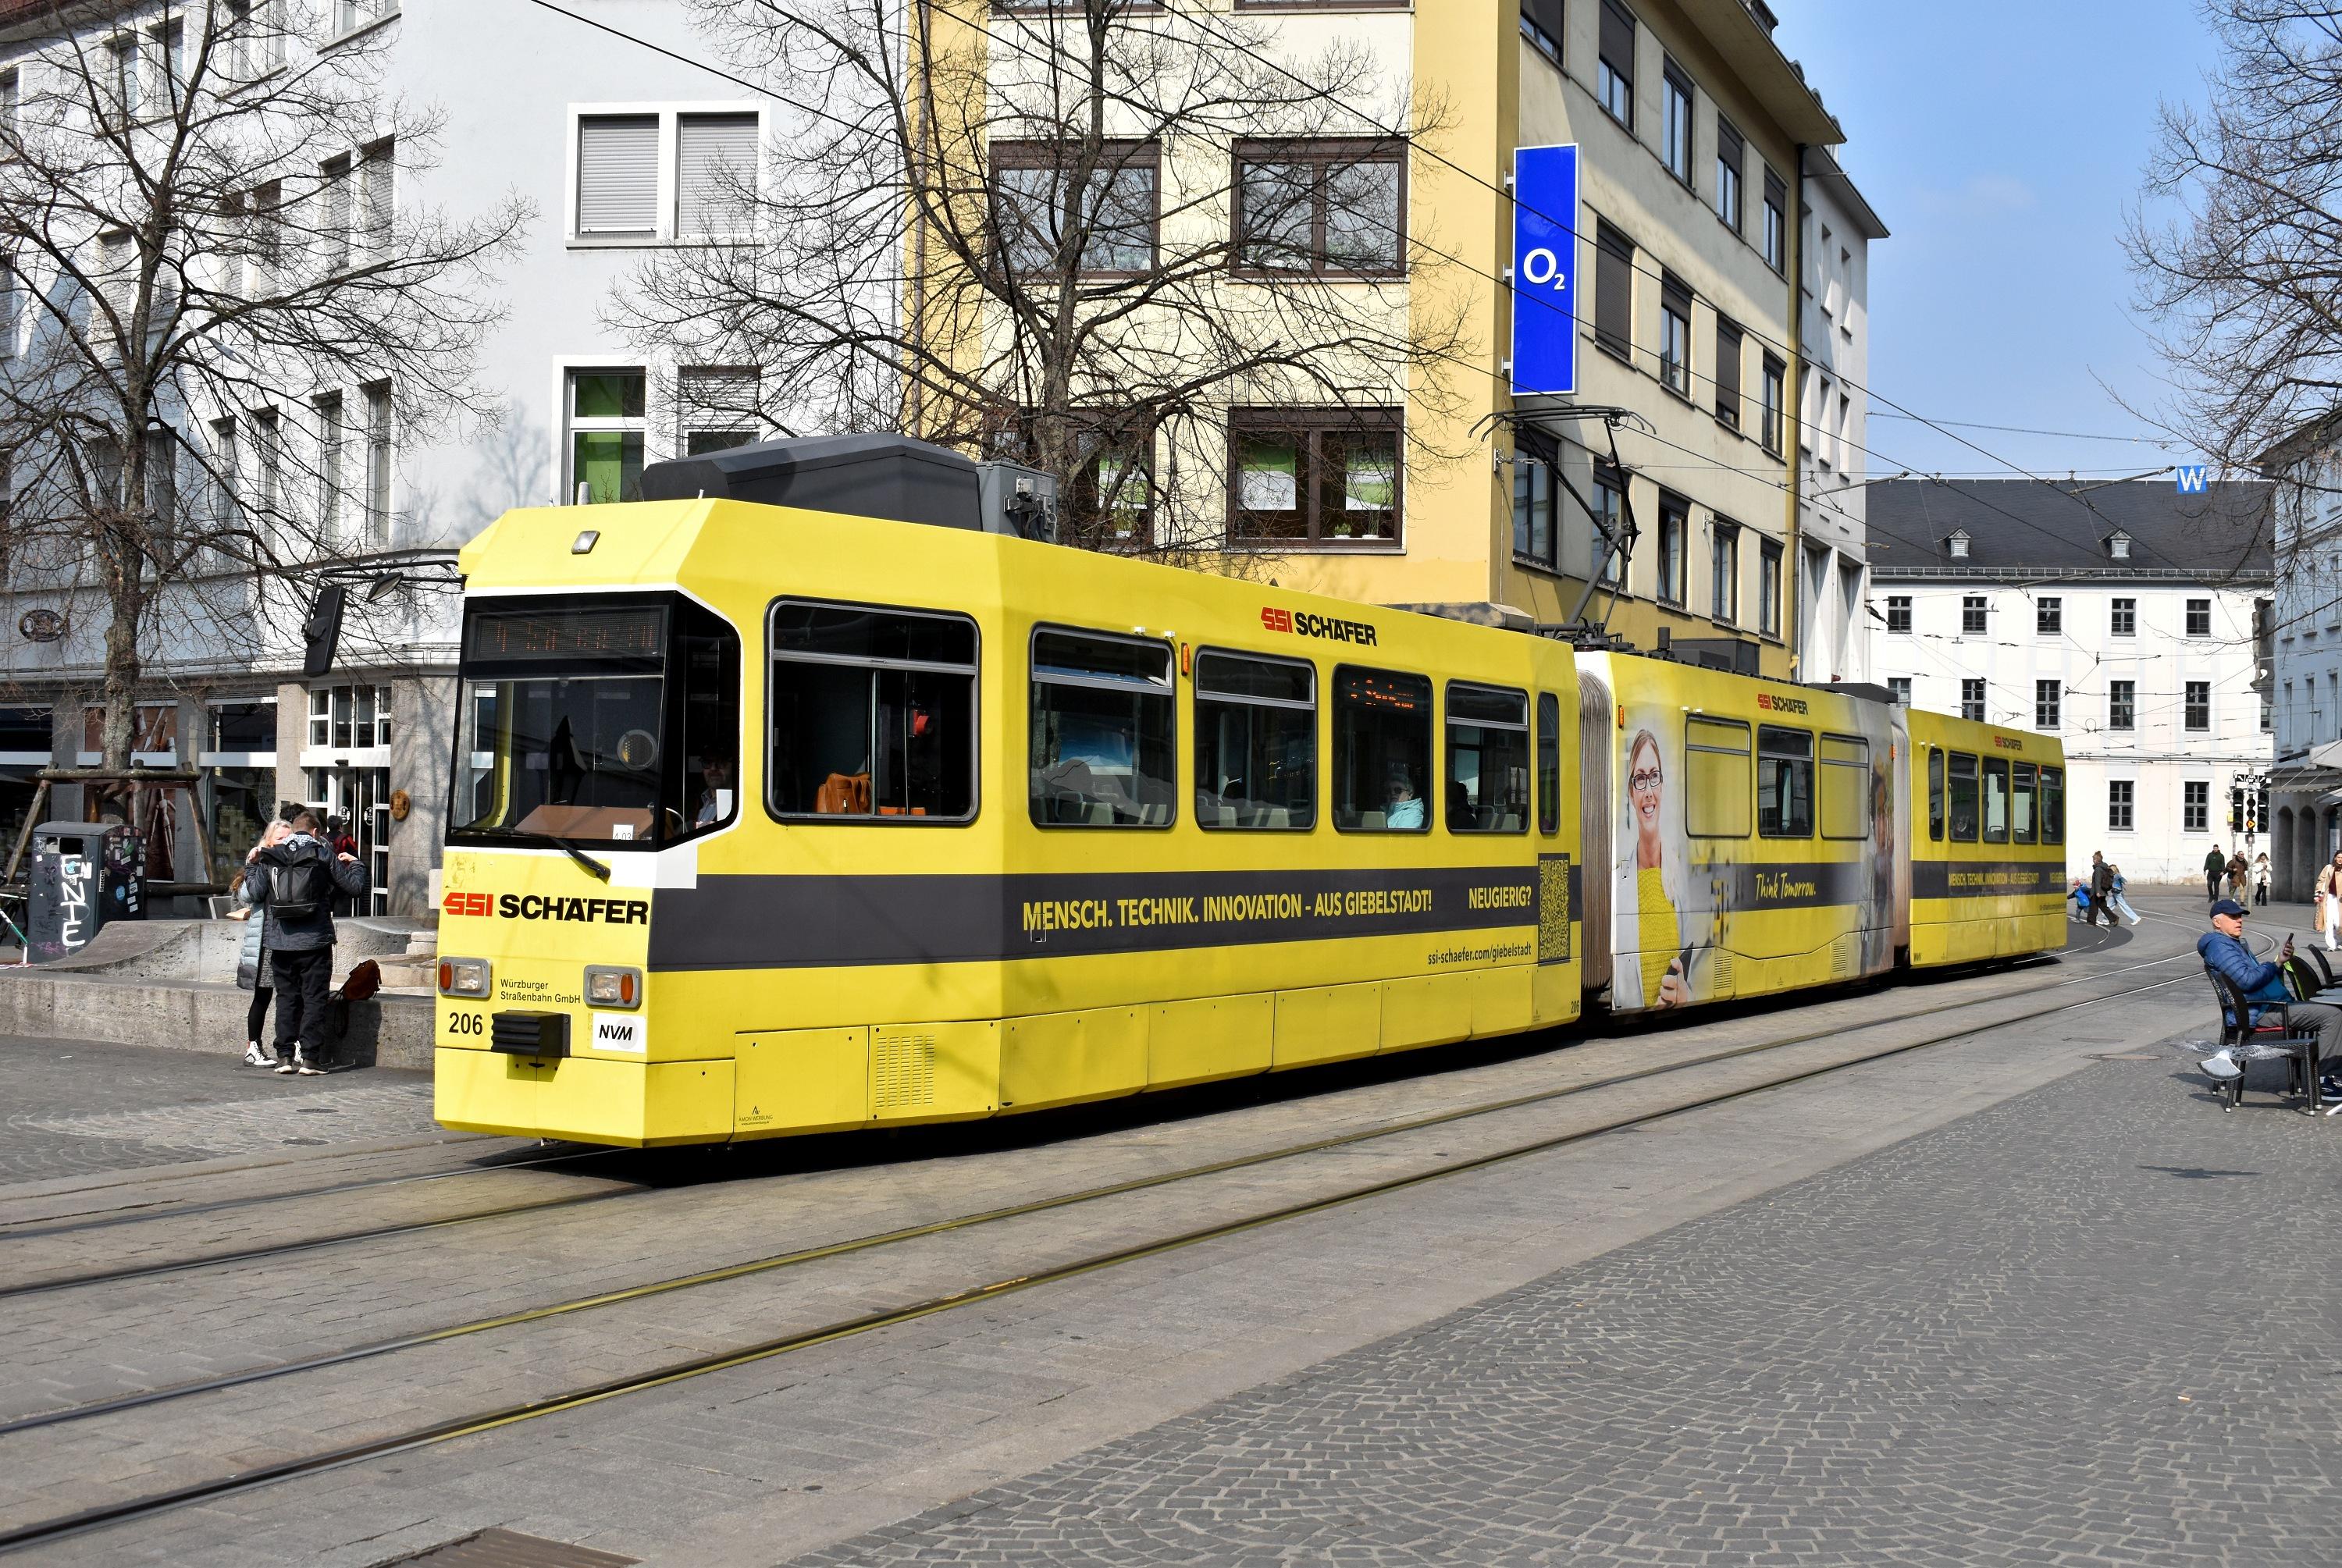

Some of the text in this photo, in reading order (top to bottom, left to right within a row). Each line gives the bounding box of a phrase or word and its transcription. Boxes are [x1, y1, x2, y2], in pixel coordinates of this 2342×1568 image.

[2178, 468, 2205, 491] W
[1261, 606, 1377, 646] SSI SCHÄFER
[1756, 873, 1816, 901] Think Tomorrow.
[443, 892, 649, 925] SSI SCHÄFER
[1023, 900, 1112, 930] MENSCH.
[1117, 897, 1199, 926] TECHNIK.
[1204, 894, 1301, 922] INNOVATION
[1314, 892, 1342, 917] AUS
[1345, 889, 1432, 916] GIEBELSTADT!
[1468, 886, 1532, 909] NEUGIERIG?
[1428, 941, 1531, 965] ssi-schaefer.com/giebelstadt
[500, 979, 548, 991] Würzburger
[500, 991, 581, 1004] Straßenbahn GmbH
[1571, 1000, 1579, 1014] 206
[449, 1012, 483, 1035] 206
[599, 1025, 632, 1040] NVM
